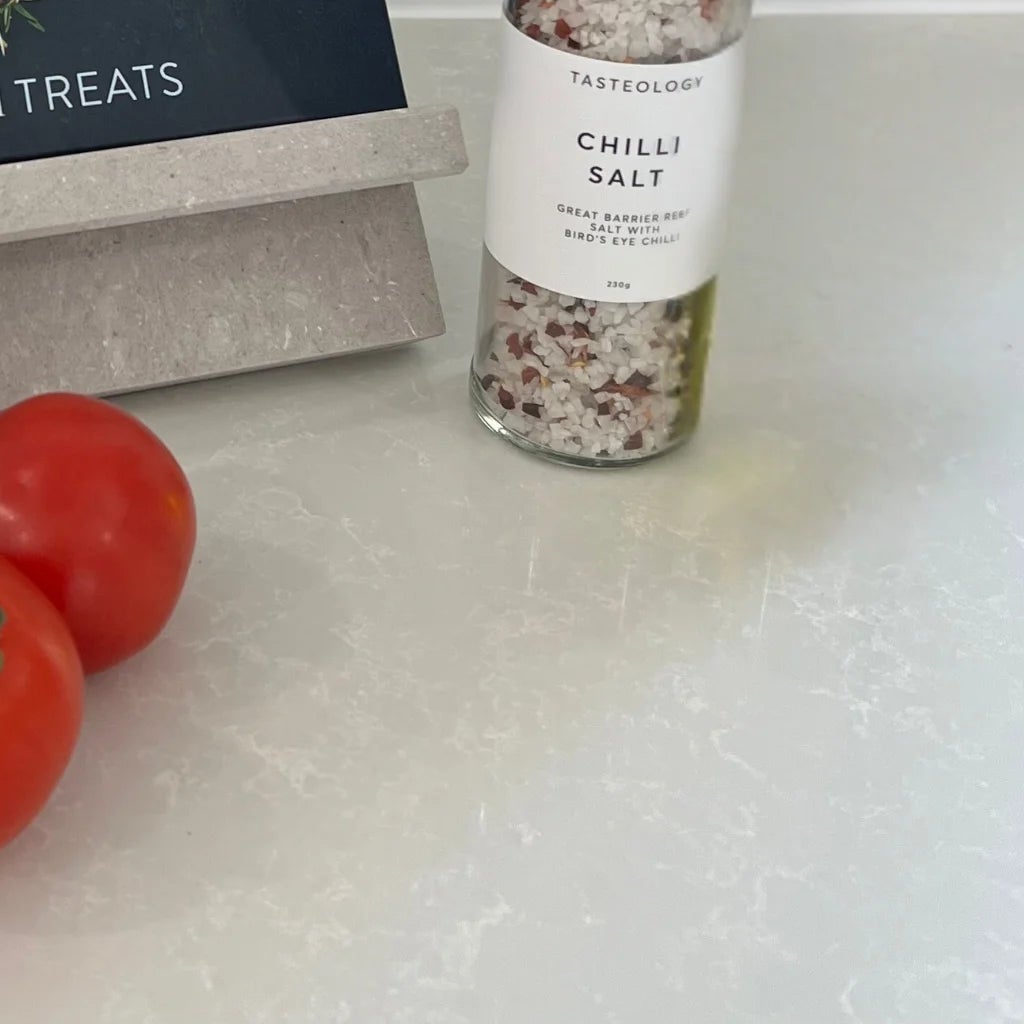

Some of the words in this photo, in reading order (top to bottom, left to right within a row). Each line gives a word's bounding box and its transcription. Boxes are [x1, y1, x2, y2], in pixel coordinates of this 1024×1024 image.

[14, 62, 184, 113] TREATS
[570, 71, 704, 93] TASTEOLOGY
[577, 132, 680, 156] CHILLI
[588, 166, 664, 187] SALT
[557, 204, 598, 220] GREAT
[604, 213, 659, 223] BARRIER
[590, 223, 622, 234] SALT
[628, 226, 660, 234] WITH
[612, 237, 635, 246] EYE
[606, 280, 631, 289] 230g
